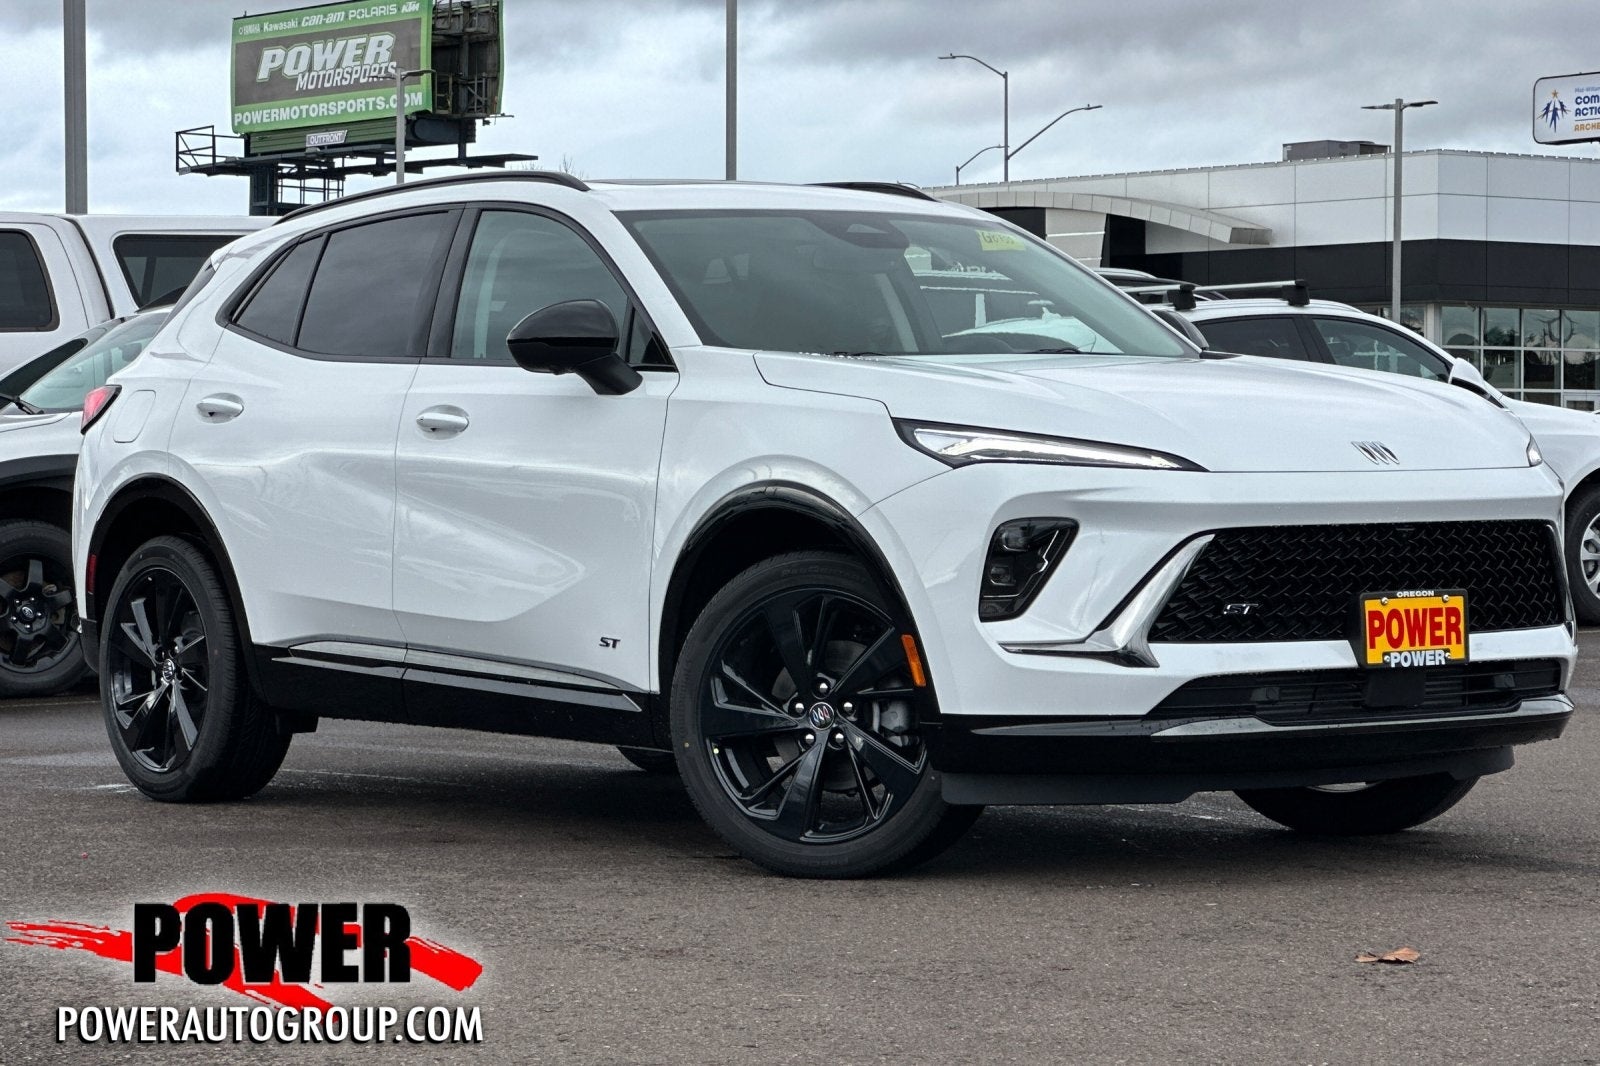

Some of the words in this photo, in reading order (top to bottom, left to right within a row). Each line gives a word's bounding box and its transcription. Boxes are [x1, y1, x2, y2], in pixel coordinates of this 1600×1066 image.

[263, 18, 298, 32] Kawasaki
[301, 11, 345, 27] can-am
[348, 4, 397, 20] POLARIS
[401, 1, 420, 14] KTM
[257, 35, 396, 81] POWER
[295, 61, 397, 91] MOTORSPORTS
[310, 132, 343, 145] OUTFRONT
[1397, 590, 1435, 598] OREGON
[1368, 606, 1462, 649] POWER
[599, 636, 621, 649] ST
[1390, 649, 1446, 668] POWER
